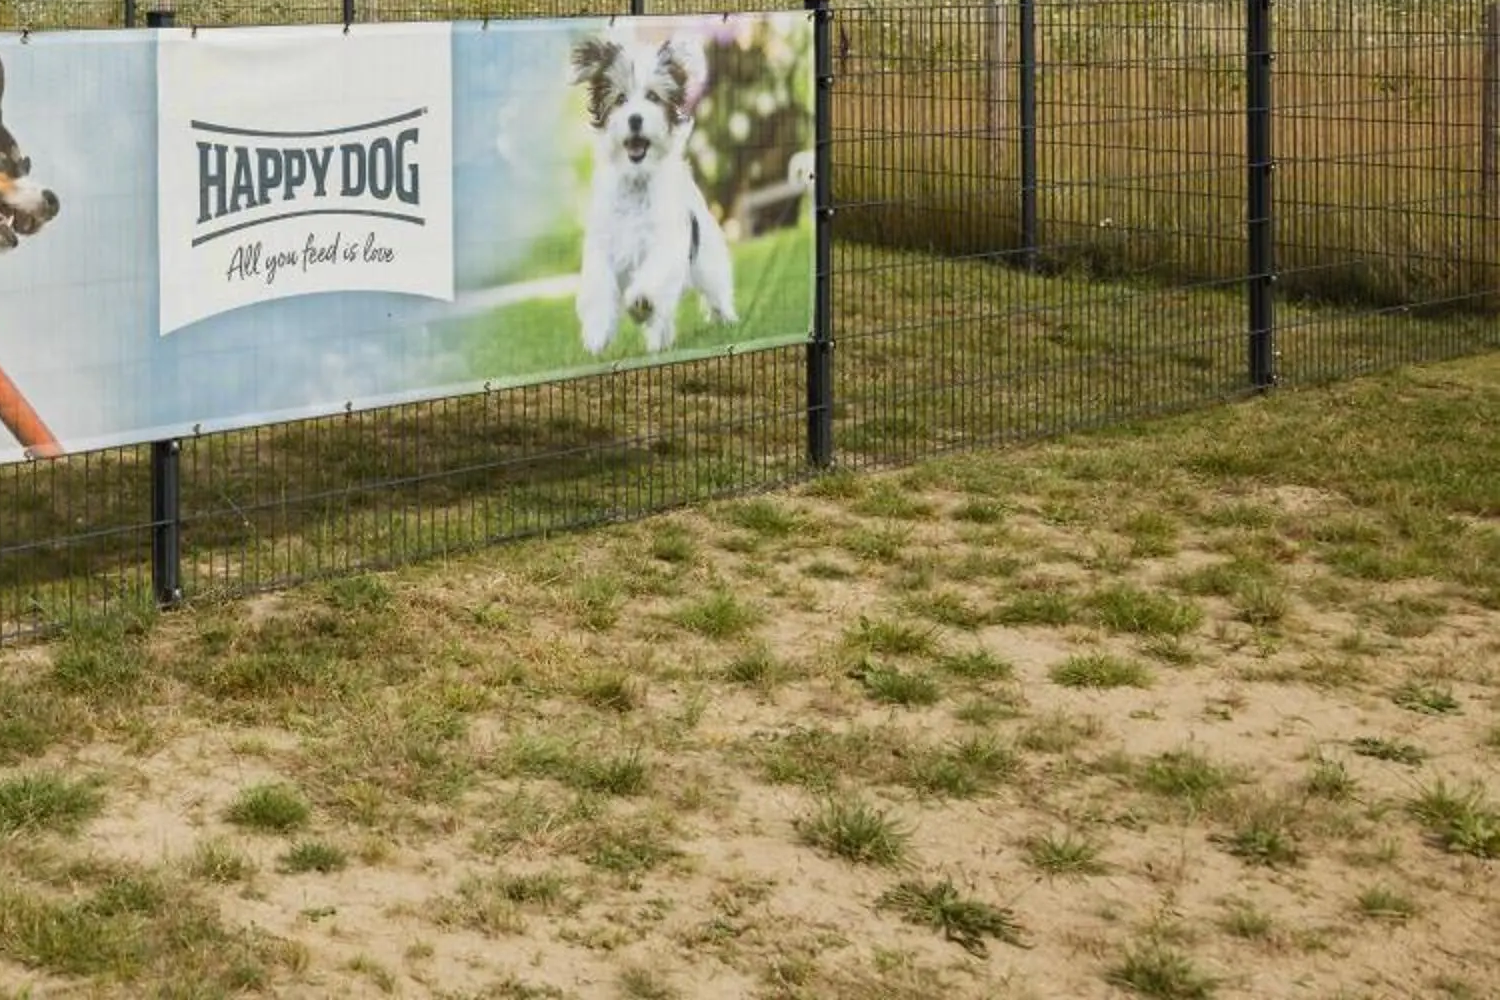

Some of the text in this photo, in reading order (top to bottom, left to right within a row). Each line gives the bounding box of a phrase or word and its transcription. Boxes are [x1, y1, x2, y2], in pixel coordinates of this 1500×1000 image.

[195, 127, 420, 225] HAPPY DOG
[226, 231, 396, 285] All you feed is love
